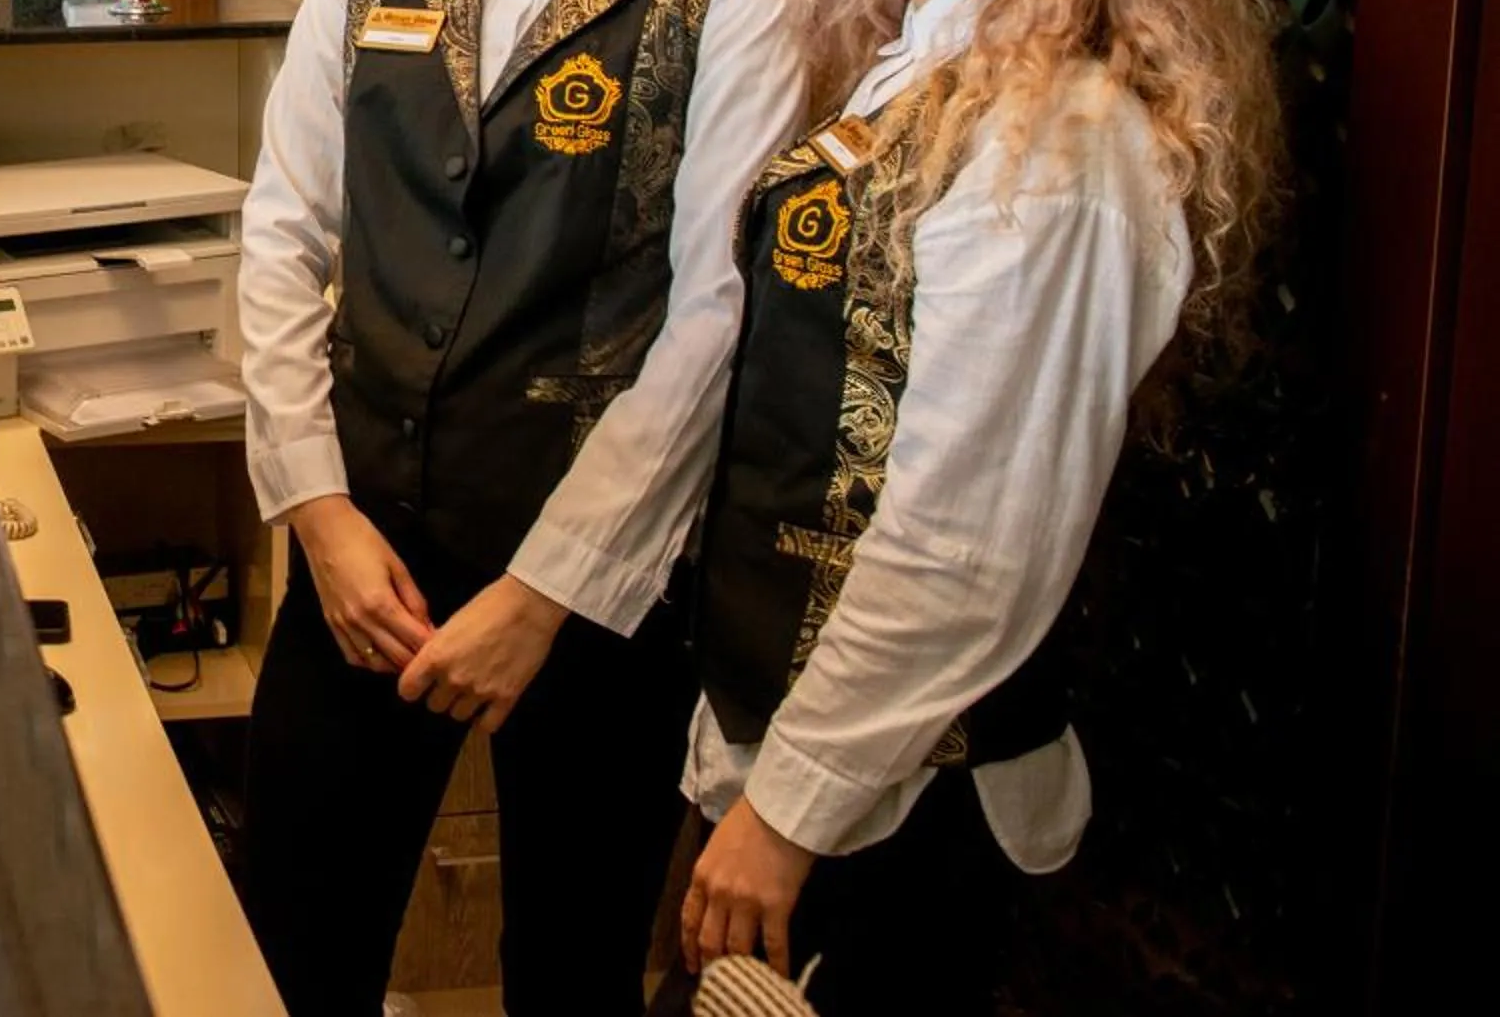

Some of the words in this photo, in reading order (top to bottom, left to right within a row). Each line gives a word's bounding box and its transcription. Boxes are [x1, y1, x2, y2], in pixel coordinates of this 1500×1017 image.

[564, 81, 589, 109] G
[535, 123, 575, 136] Green
[797, 206, 820, 238] G
